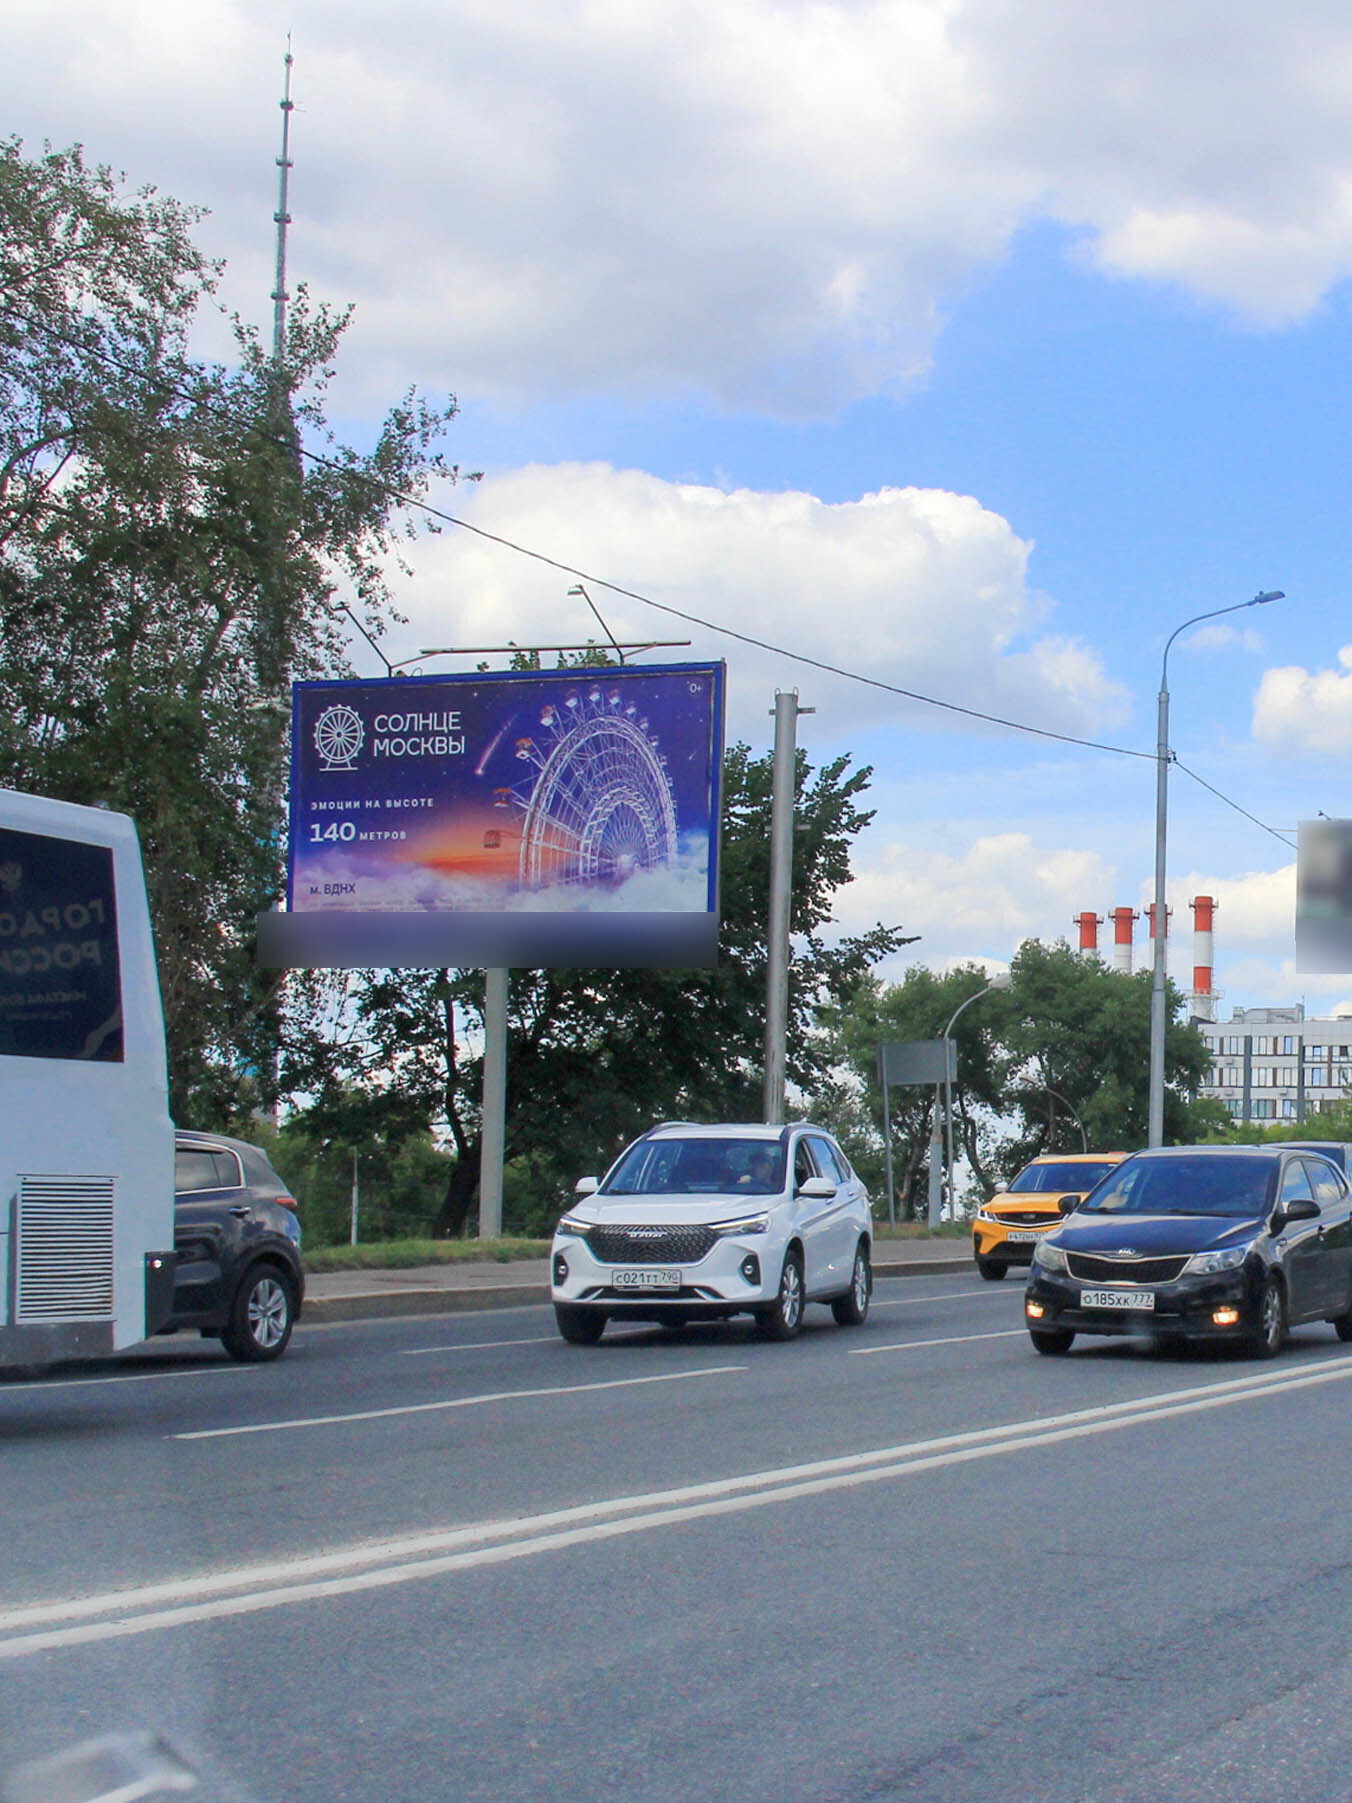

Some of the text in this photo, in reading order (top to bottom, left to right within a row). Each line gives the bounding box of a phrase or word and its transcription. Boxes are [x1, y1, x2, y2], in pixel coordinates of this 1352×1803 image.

[374, 711, 461, 733] СОЛНЦЕ
[373, 735, 465, 757] МОСКВЫ
[311, 798, 434, 811] ЭМОЦИИ НА ВЫСОТЕ
[310, 822, 406, 843] 140 МЕТРОВ
[323, 883, 356, 896] ВДНХ
